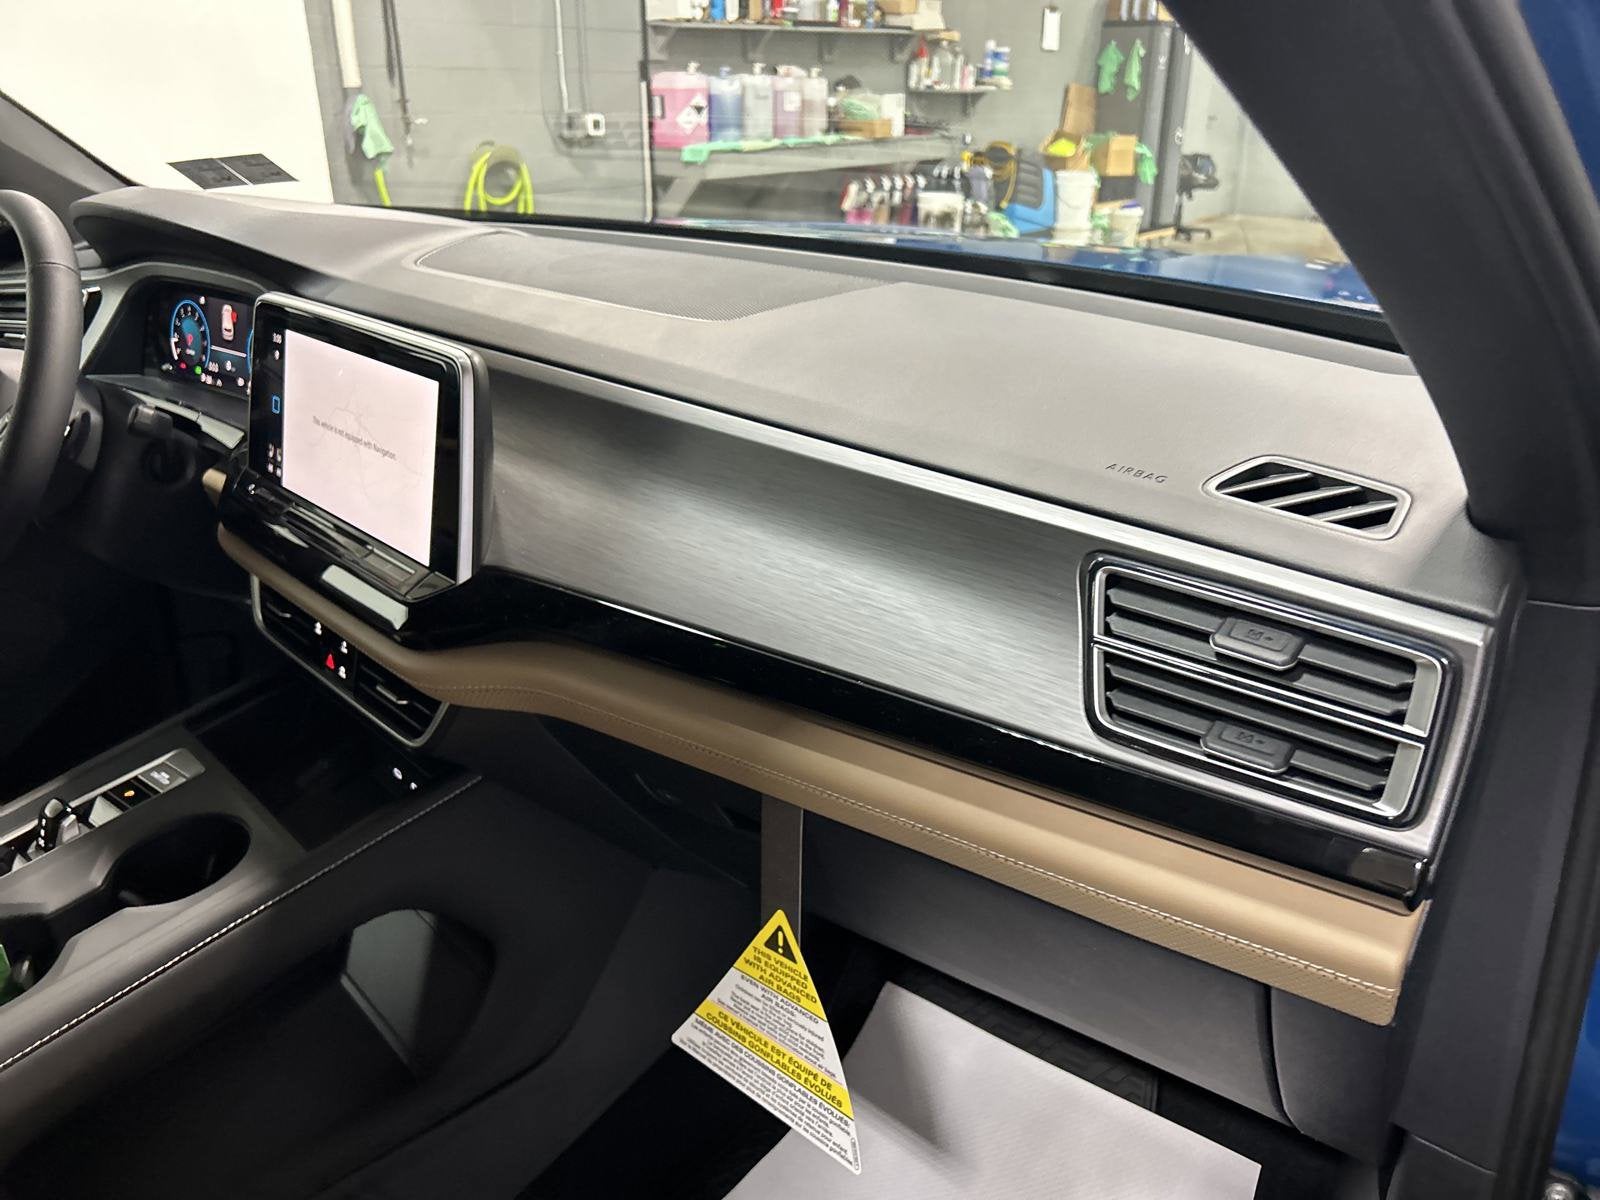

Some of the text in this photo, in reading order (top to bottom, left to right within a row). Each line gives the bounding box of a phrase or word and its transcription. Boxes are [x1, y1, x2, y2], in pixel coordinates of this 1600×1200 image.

[1106, 463, 1168, 483] AIRBAG
[744, 957, 766, 974] WITH
[769, 972, 816, 1003] ADVANCED
[752, 946, 808, 981] THIS VEHICLE
[753, 954, 807, 989] IS EQUIPPED
[740, 974, 758, 988] EVEN
[760, 987, 778, 1000] WITH
[780, 998, 818, 1024] ADVANCED
[758, 974, 801, 1002] AIR BAGS
[706, 1012, 746, 1042] COUSSINS
[746, 1040, 801, 1079] GONFLABLES
[804, 1077, 842, 1107] ÉVOLUÉS
[718, 1011, 728, 1022] CE
[730, 1019, 768, 1048] VÉHICULE
[770, 1045, 786, 1059] EST
[788, 1056, 818, 1081] ÉQUIPÉ
[820, 1078, 832, 1090] DE
